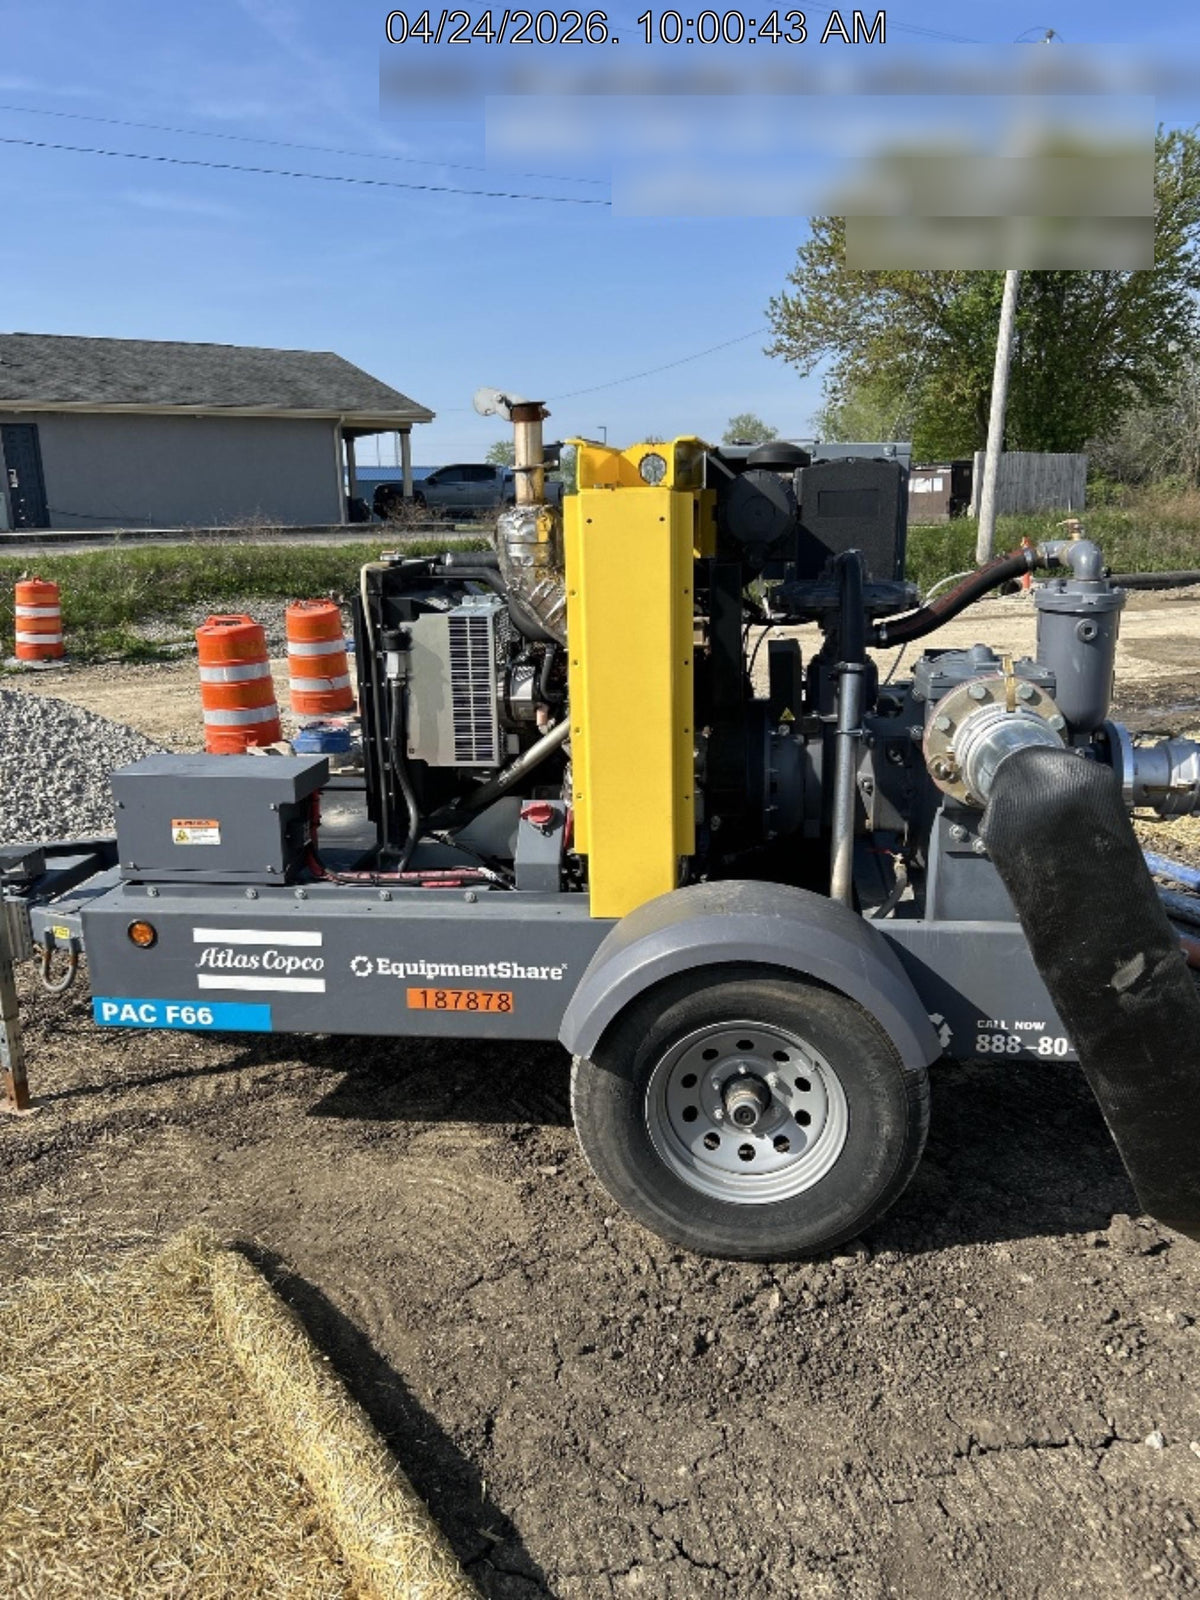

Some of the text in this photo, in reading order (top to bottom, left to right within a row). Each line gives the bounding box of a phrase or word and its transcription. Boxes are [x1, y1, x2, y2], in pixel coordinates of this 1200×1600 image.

[195, 947, 325, 975] Atlas Copco
[419, 989, 511, 1013] 187878
[101, 1002, 214, 1025] PAC F66
[977, 1019, 1047, 1031] CALL NOW
[975, 1033, 1076, 1056] 888-80-
